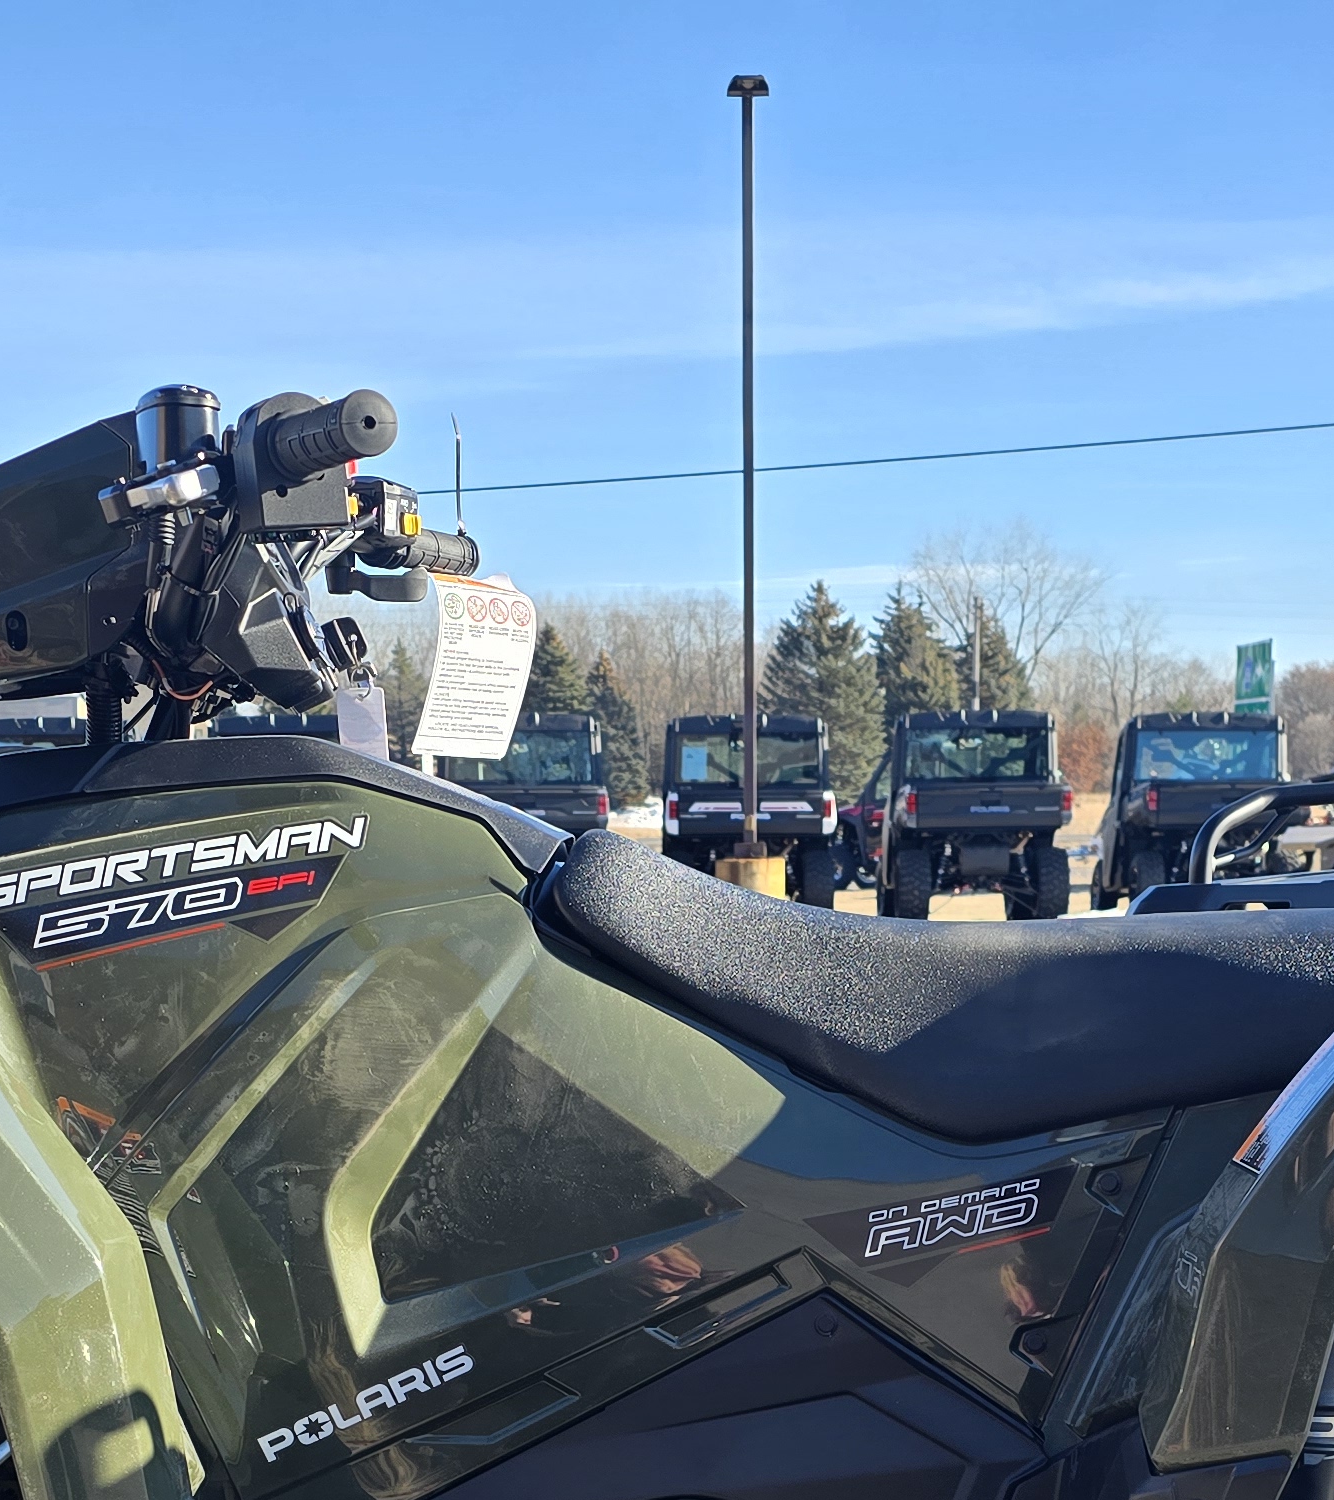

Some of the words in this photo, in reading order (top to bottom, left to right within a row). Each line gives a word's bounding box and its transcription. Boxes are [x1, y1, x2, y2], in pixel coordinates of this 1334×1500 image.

[33, 876, 243, 949] 570
[247, 870, 315, 895] EFI
[864, 1193, 1039, 1258] AWD
[869, 1206, 908, 1223] ON
[920, 1178, 1041, 1213] DEMAND
[256, 1345, 474, 1463] POLARIS
